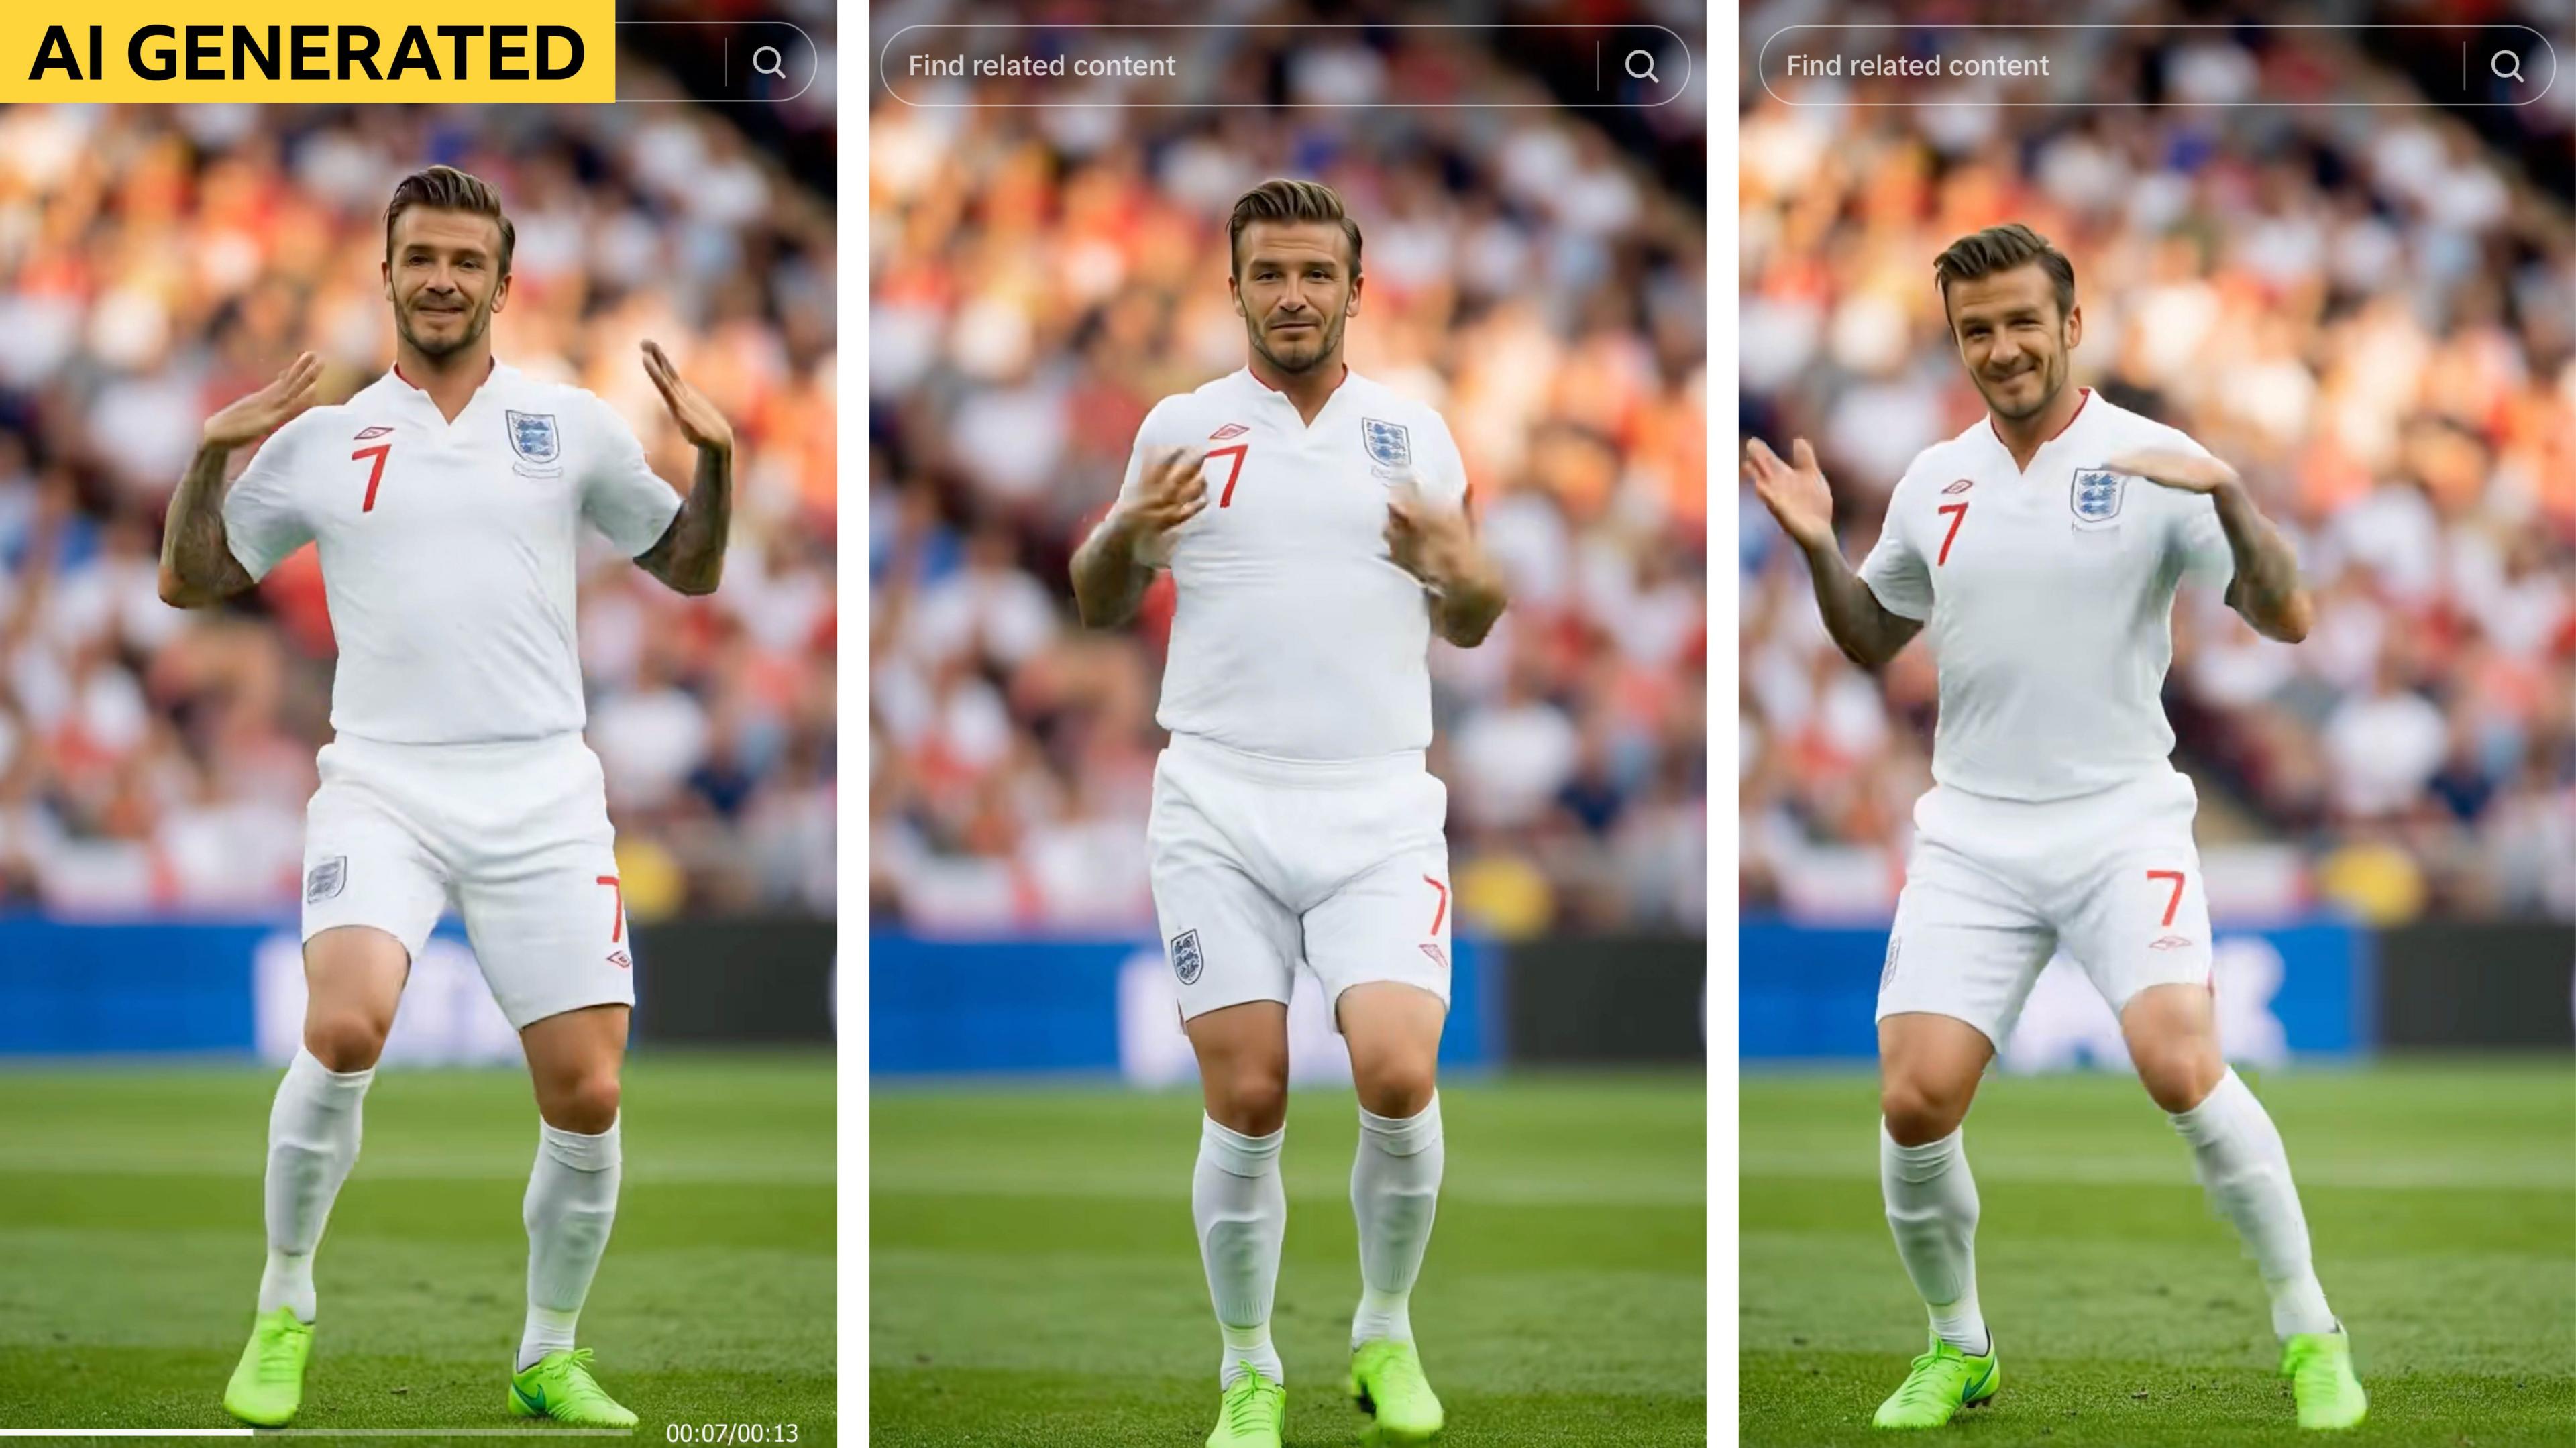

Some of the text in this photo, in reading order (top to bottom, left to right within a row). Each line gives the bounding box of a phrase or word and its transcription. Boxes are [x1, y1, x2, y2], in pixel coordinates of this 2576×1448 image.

[352, 443, 392, 512] 7
[1205, 443, 1248, 509] 7
[1937, 502, 1969, 567] 7
[596, 875, 623, 944] 7
[1423, 874, 1447, 936] 7
[2146, 869, 2186, 927] 7
